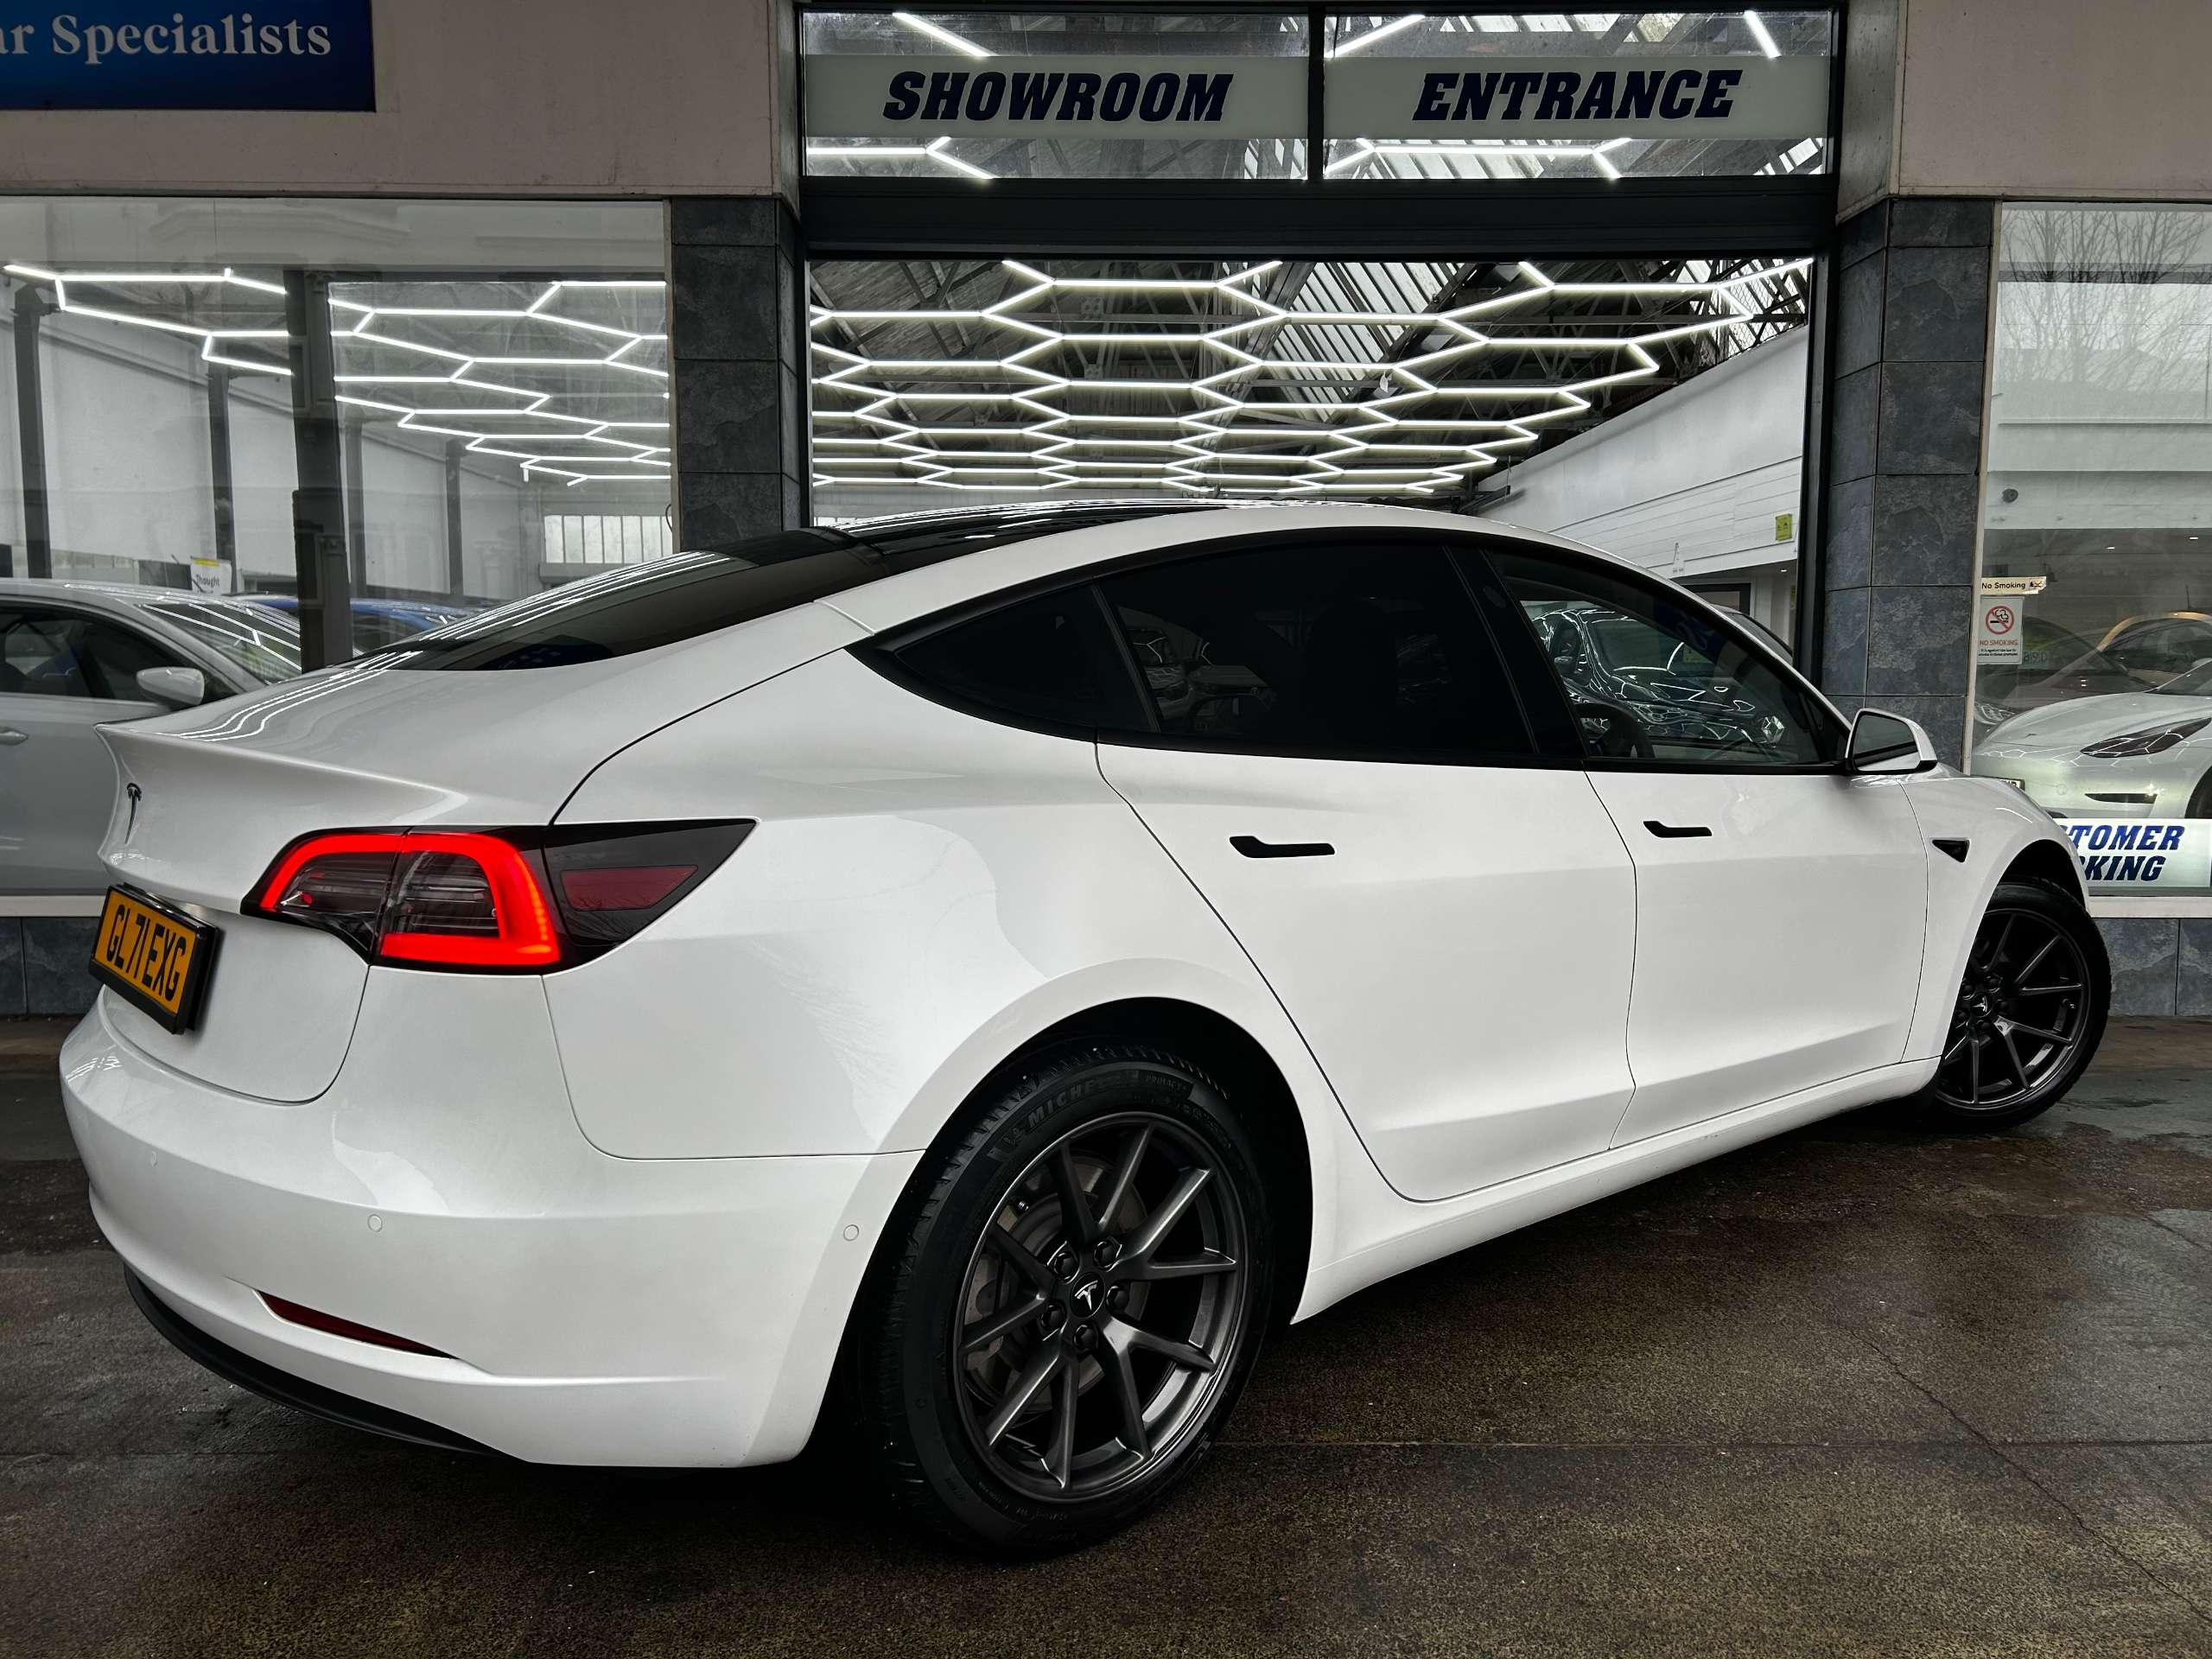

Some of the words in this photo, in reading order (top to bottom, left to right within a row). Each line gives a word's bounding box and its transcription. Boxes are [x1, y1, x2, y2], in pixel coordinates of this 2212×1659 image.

[52, 13, 332, 64] Specialists
[882, 71, 1234, 122] SHOWROOM
[1412, 69, 1744, 121] ENTRANCE
[2060, 824, 2185, 850] TOMER
[2079, 855, 2167, 881] KING
